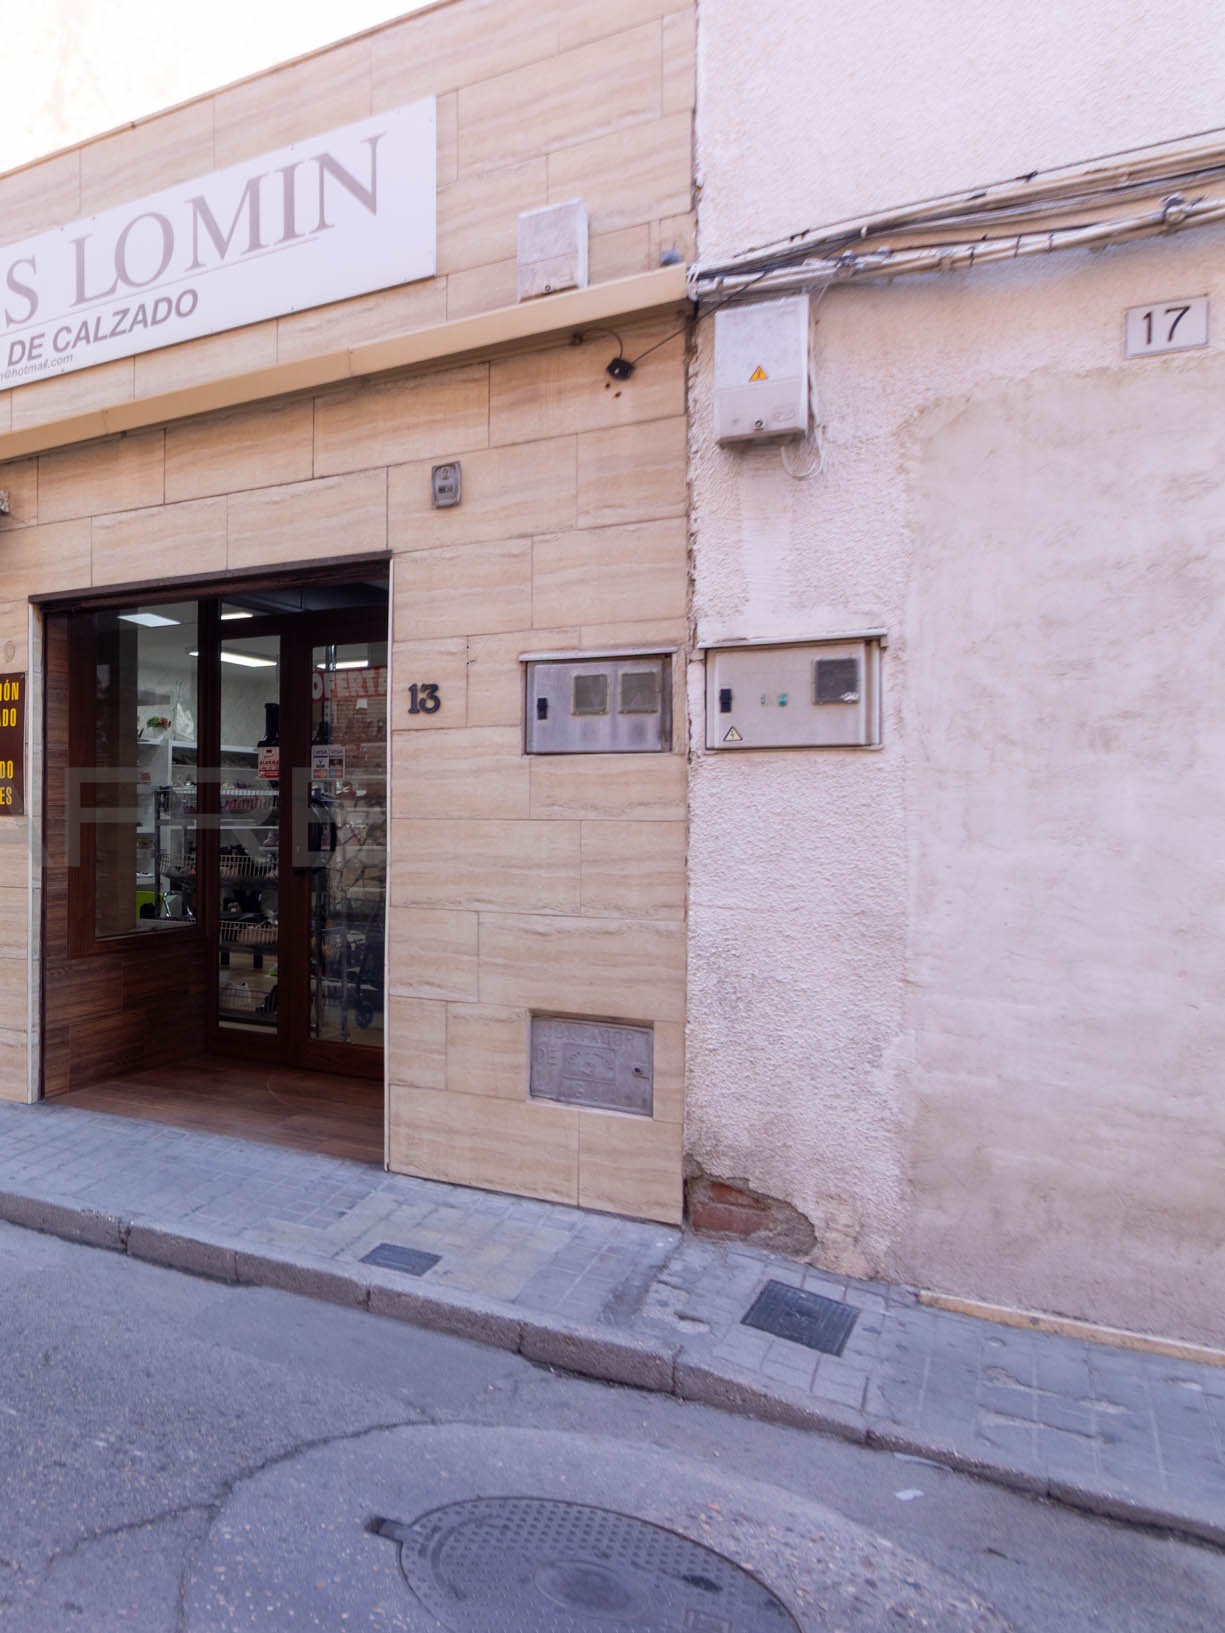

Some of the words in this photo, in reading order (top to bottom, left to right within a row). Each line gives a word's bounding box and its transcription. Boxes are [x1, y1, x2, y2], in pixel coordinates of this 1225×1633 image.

[70, 132, 387, 308] LOMIN
[7, 332, 45, 367] DE
[53, 289, 198, 353] CALZADO
[1143, 305, 1190, 345] 17
[408, 683, 440, 713] 13
